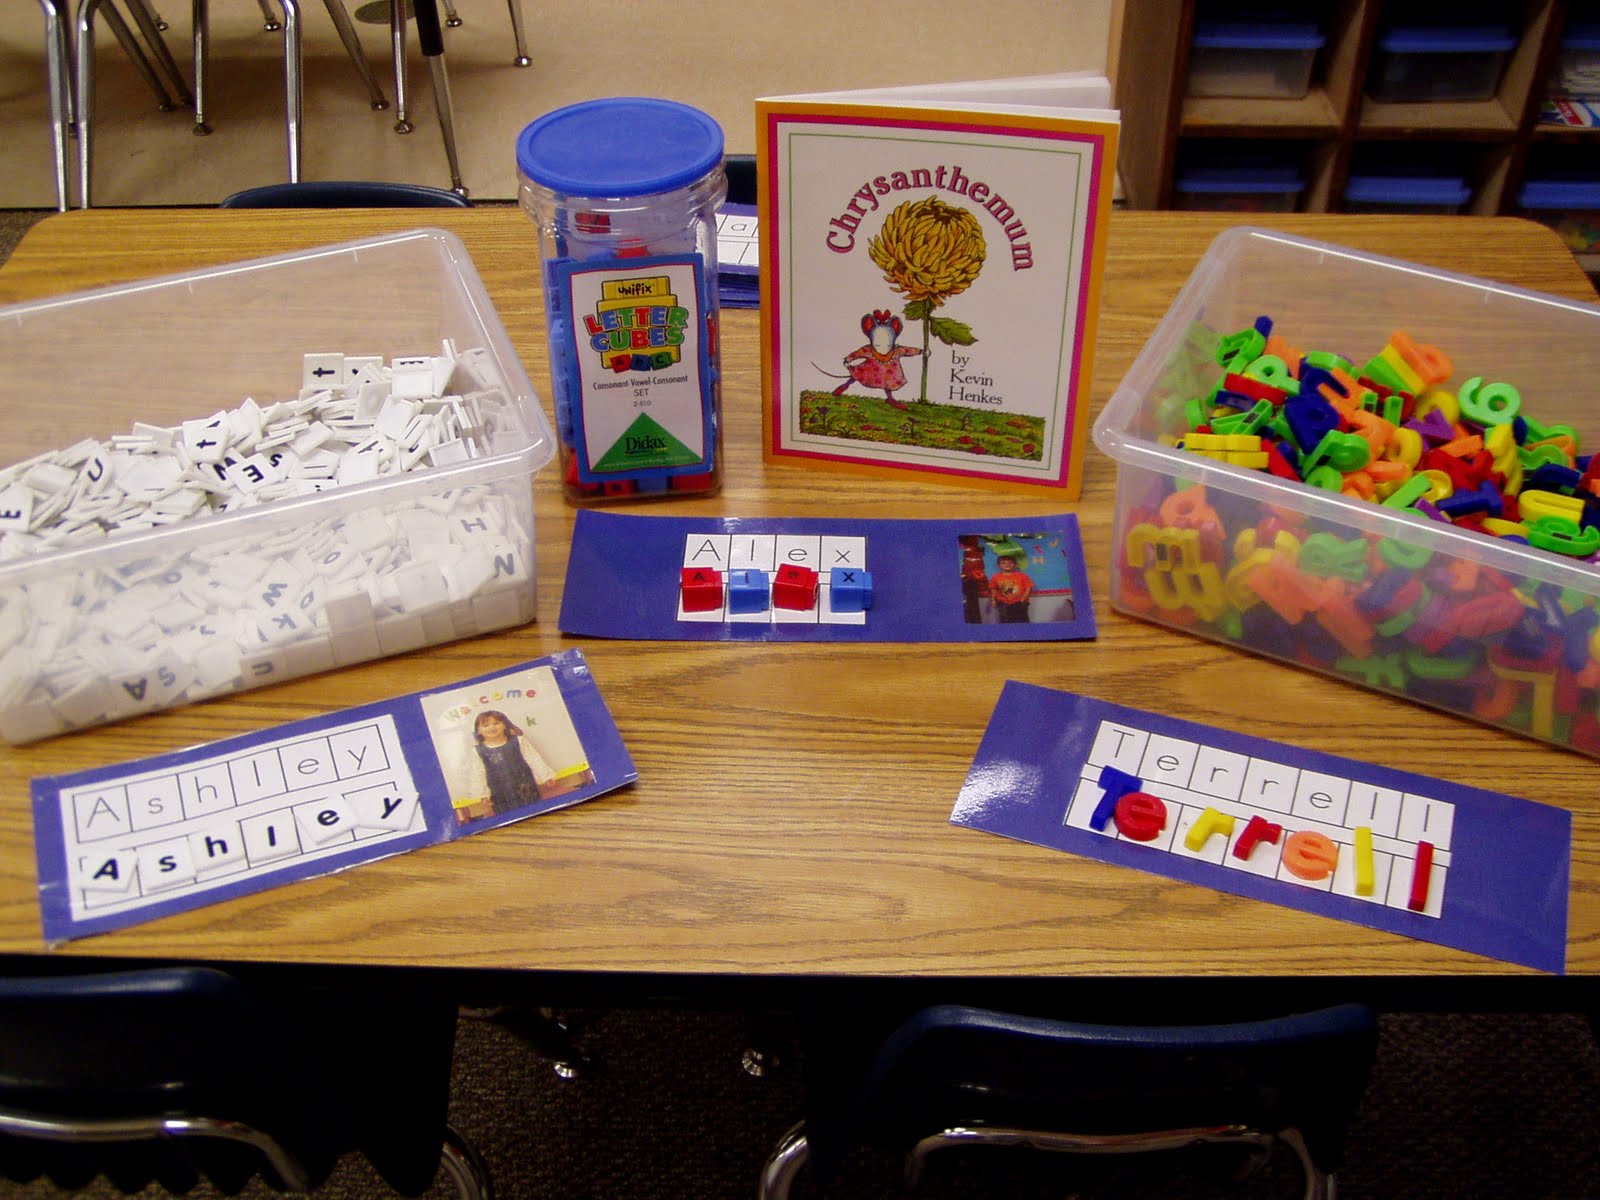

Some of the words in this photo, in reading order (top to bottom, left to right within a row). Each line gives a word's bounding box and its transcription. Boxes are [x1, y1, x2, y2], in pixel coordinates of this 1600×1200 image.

[826, 165, 1034, 271] Chrysanthemum
[583, 306, 689, 335] LETTER
[590, 326, 685, 352] CUBES
[952, 350, 970, 367] by
[950, 369, 993, 386] Kevin
[634, 388, 649, 397] SET
[949, 386, 1003, 404] Henkes
[625, 435, 666, 451] Didax
[692, 539, 851, 562] Alex
[445, 689, 536, 720] Wecome
[87, 746, 367, 828] Ashley
[1113, 729, 1430, 832] Terrell
[93, 797, 402, 880] Ashley
[1089, 765, 1434, 911] Terrell
